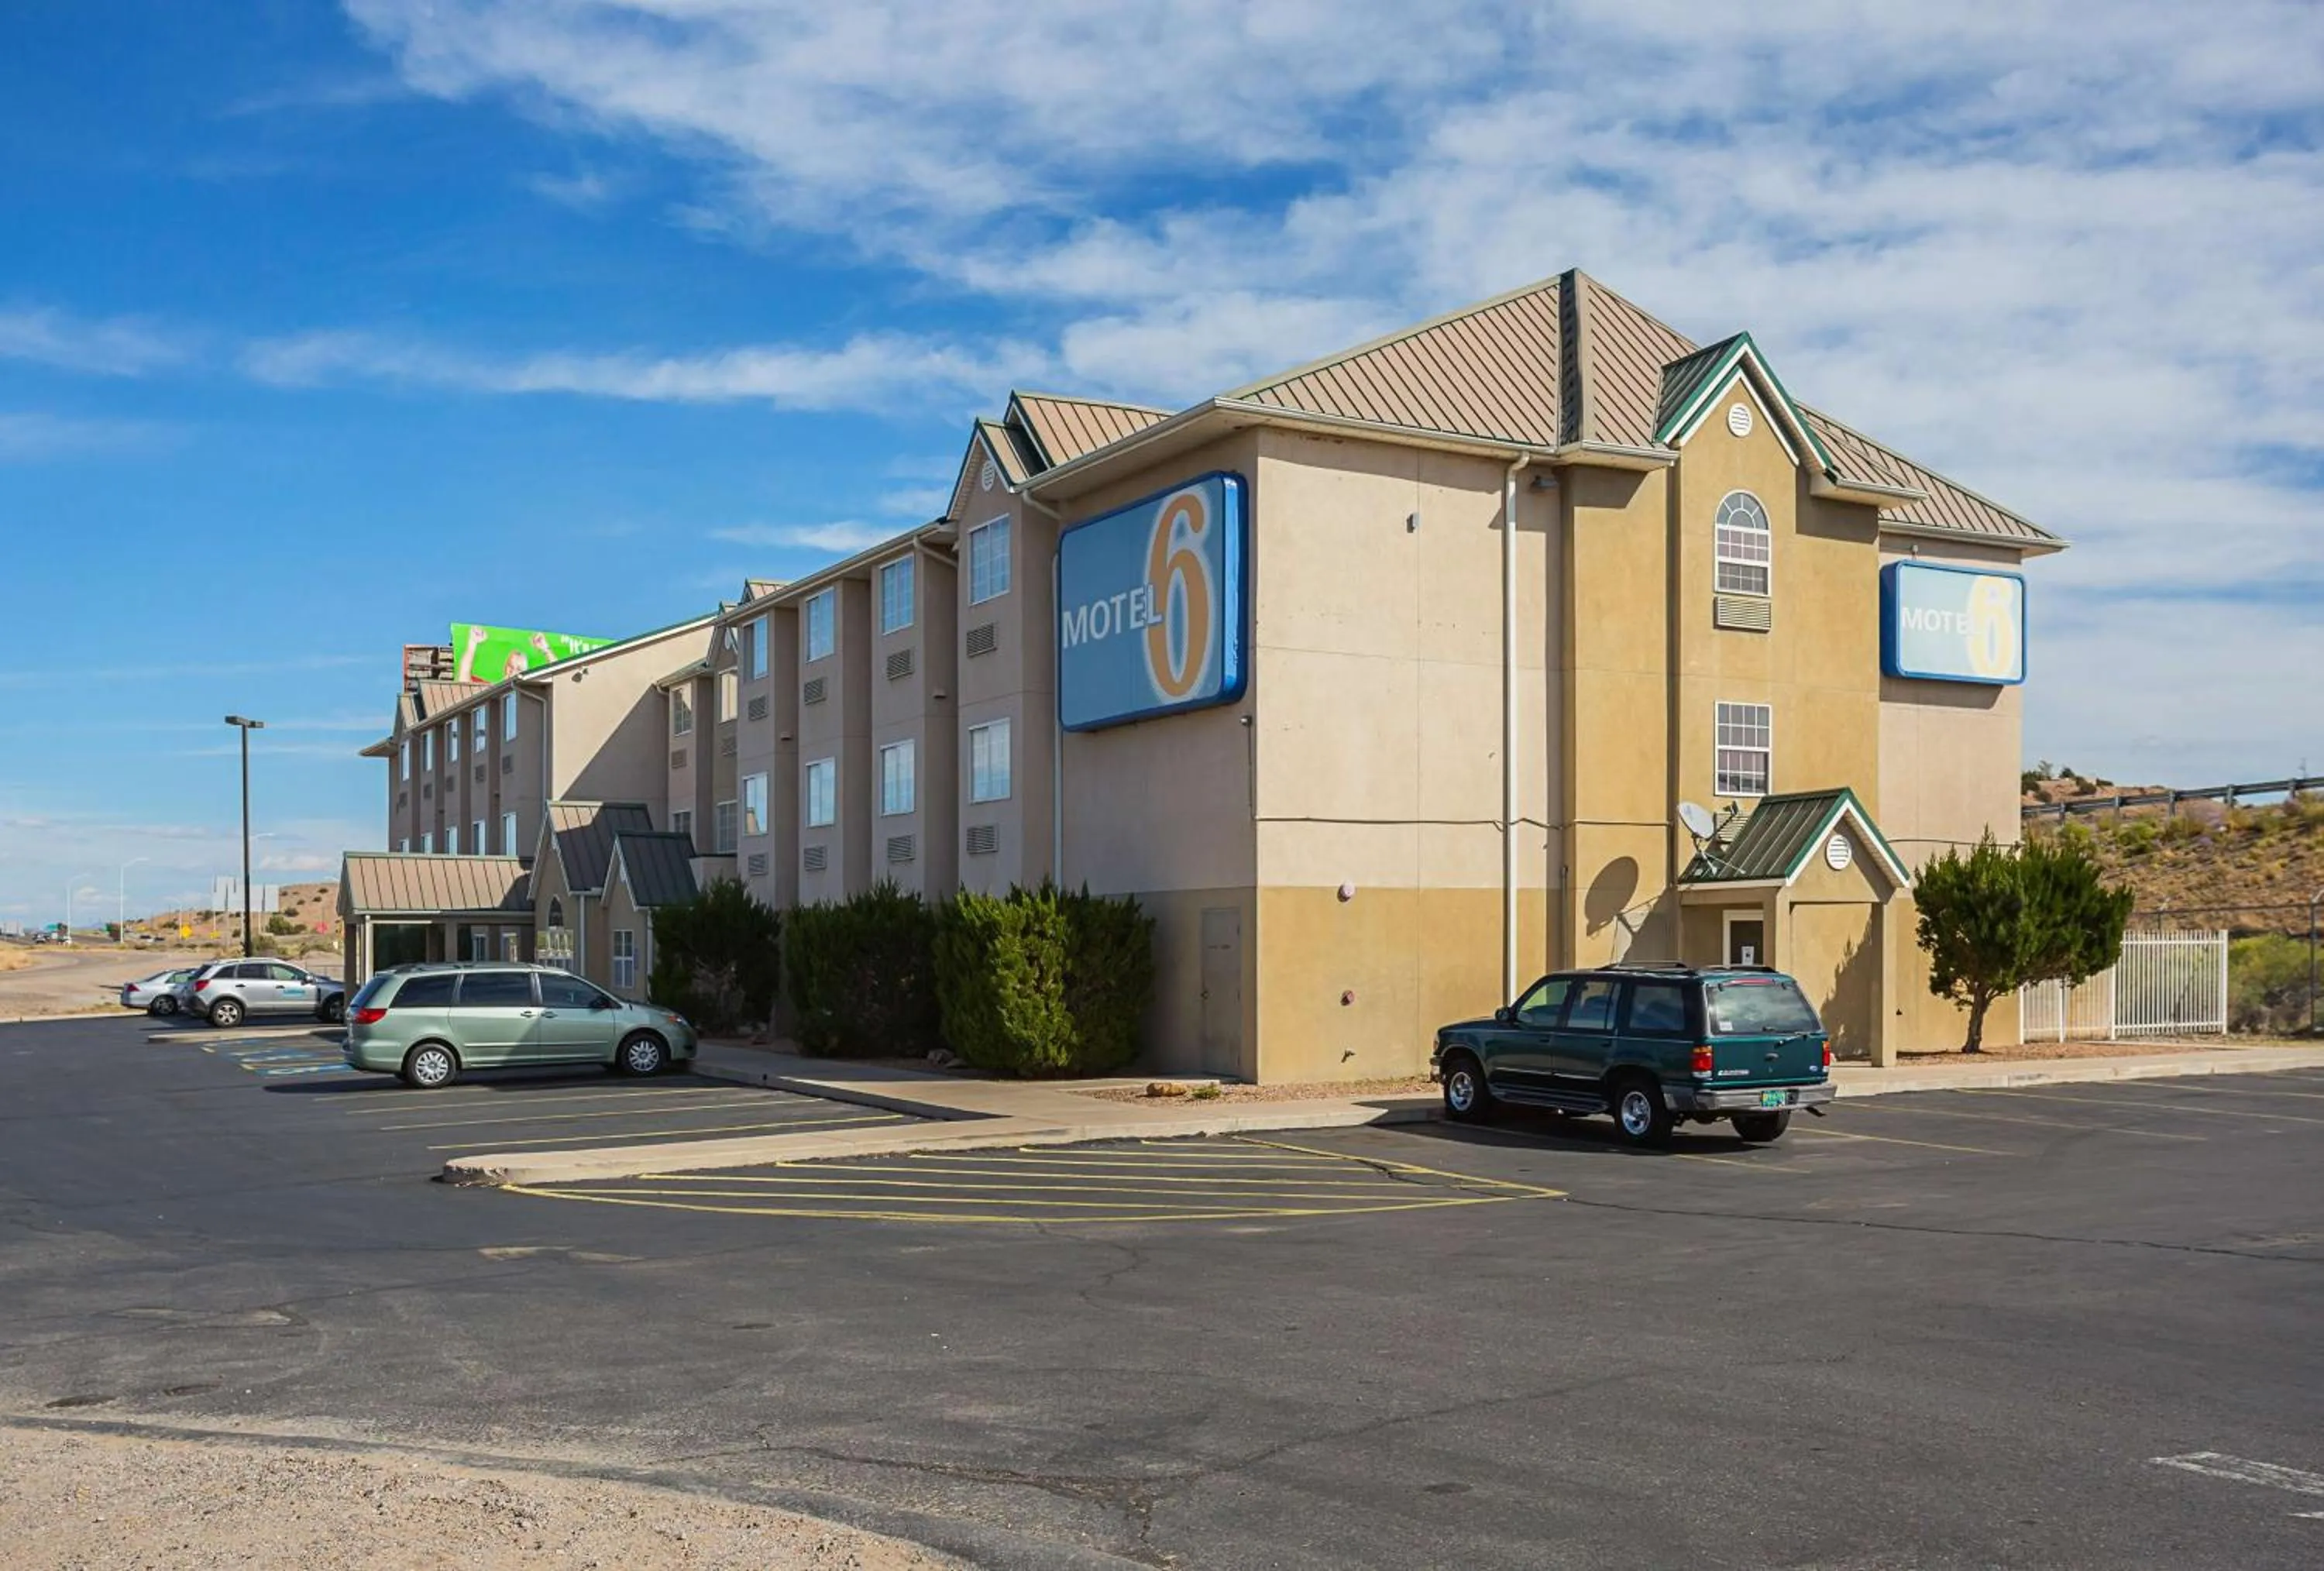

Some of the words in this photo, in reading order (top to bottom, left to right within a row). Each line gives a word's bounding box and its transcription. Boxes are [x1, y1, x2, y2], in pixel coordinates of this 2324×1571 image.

[1062, 584, 1163, 649] MOTEL
[1144, 491, 1211, 699] 6
[1902, 607, 1983, 635] MOTEL
[1968, 576, 2015, 675] 6
